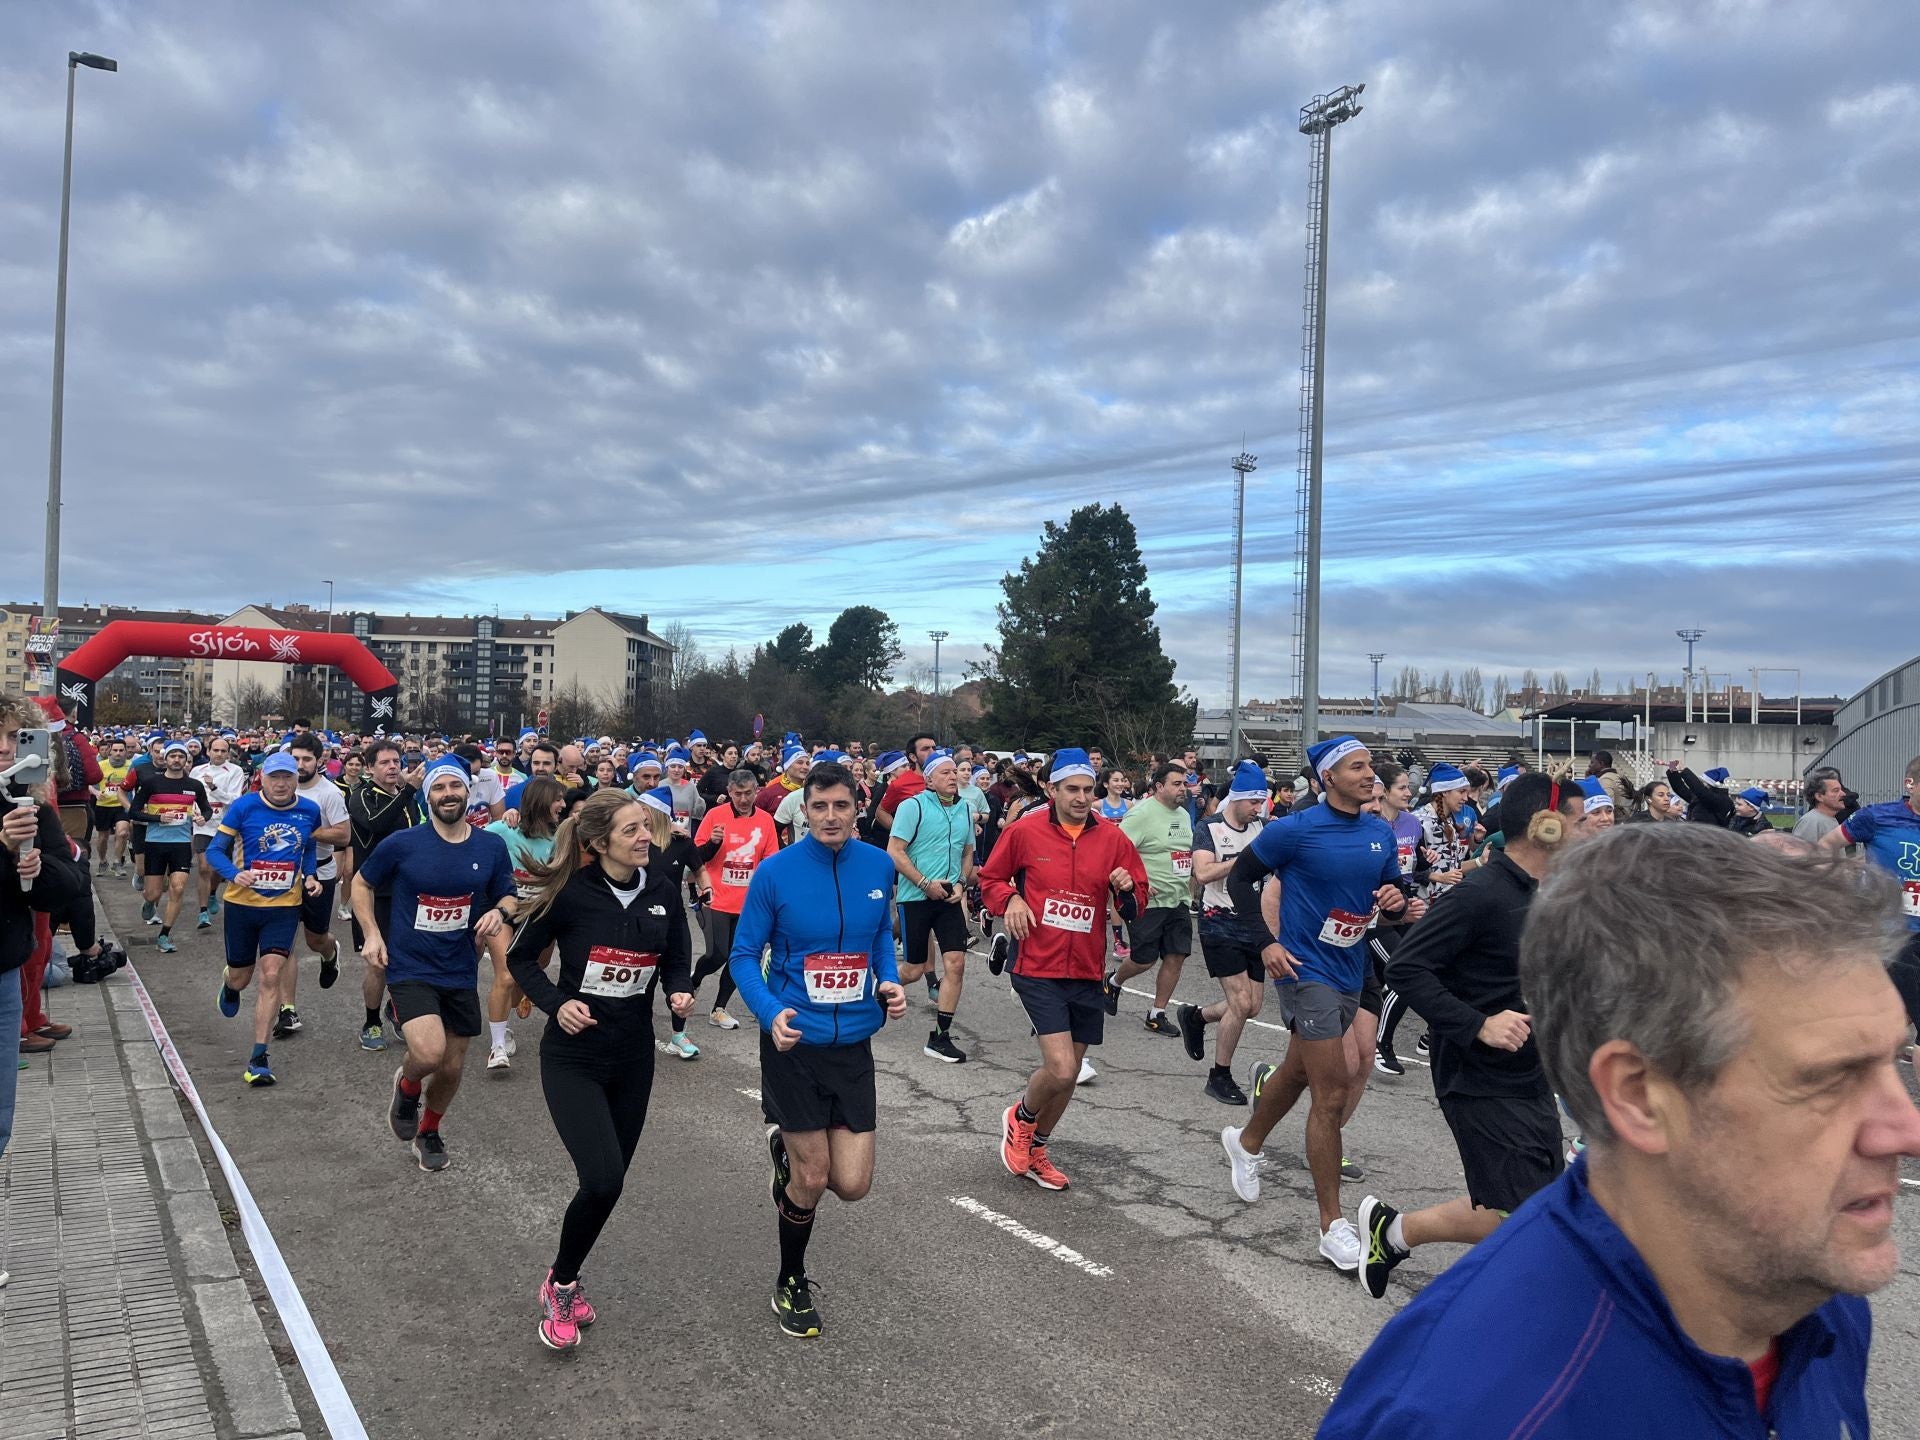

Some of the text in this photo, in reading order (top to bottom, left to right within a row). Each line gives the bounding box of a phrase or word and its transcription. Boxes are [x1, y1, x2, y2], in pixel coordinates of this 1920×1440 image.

[47, 635, 56, 643] DE
[26, 643, 51, 652] NAVIDAD
[257, 871, 287, 882] 1194
[729, 870, 750, 880] 1121
[425, 908, 463, 922] 1973
[1047, 901, 1092, 921] 2000
[1333, 922, 1367, 938] 169
[601, 965, 642, 984] 501
[813, 971, 859, 989] 1528
